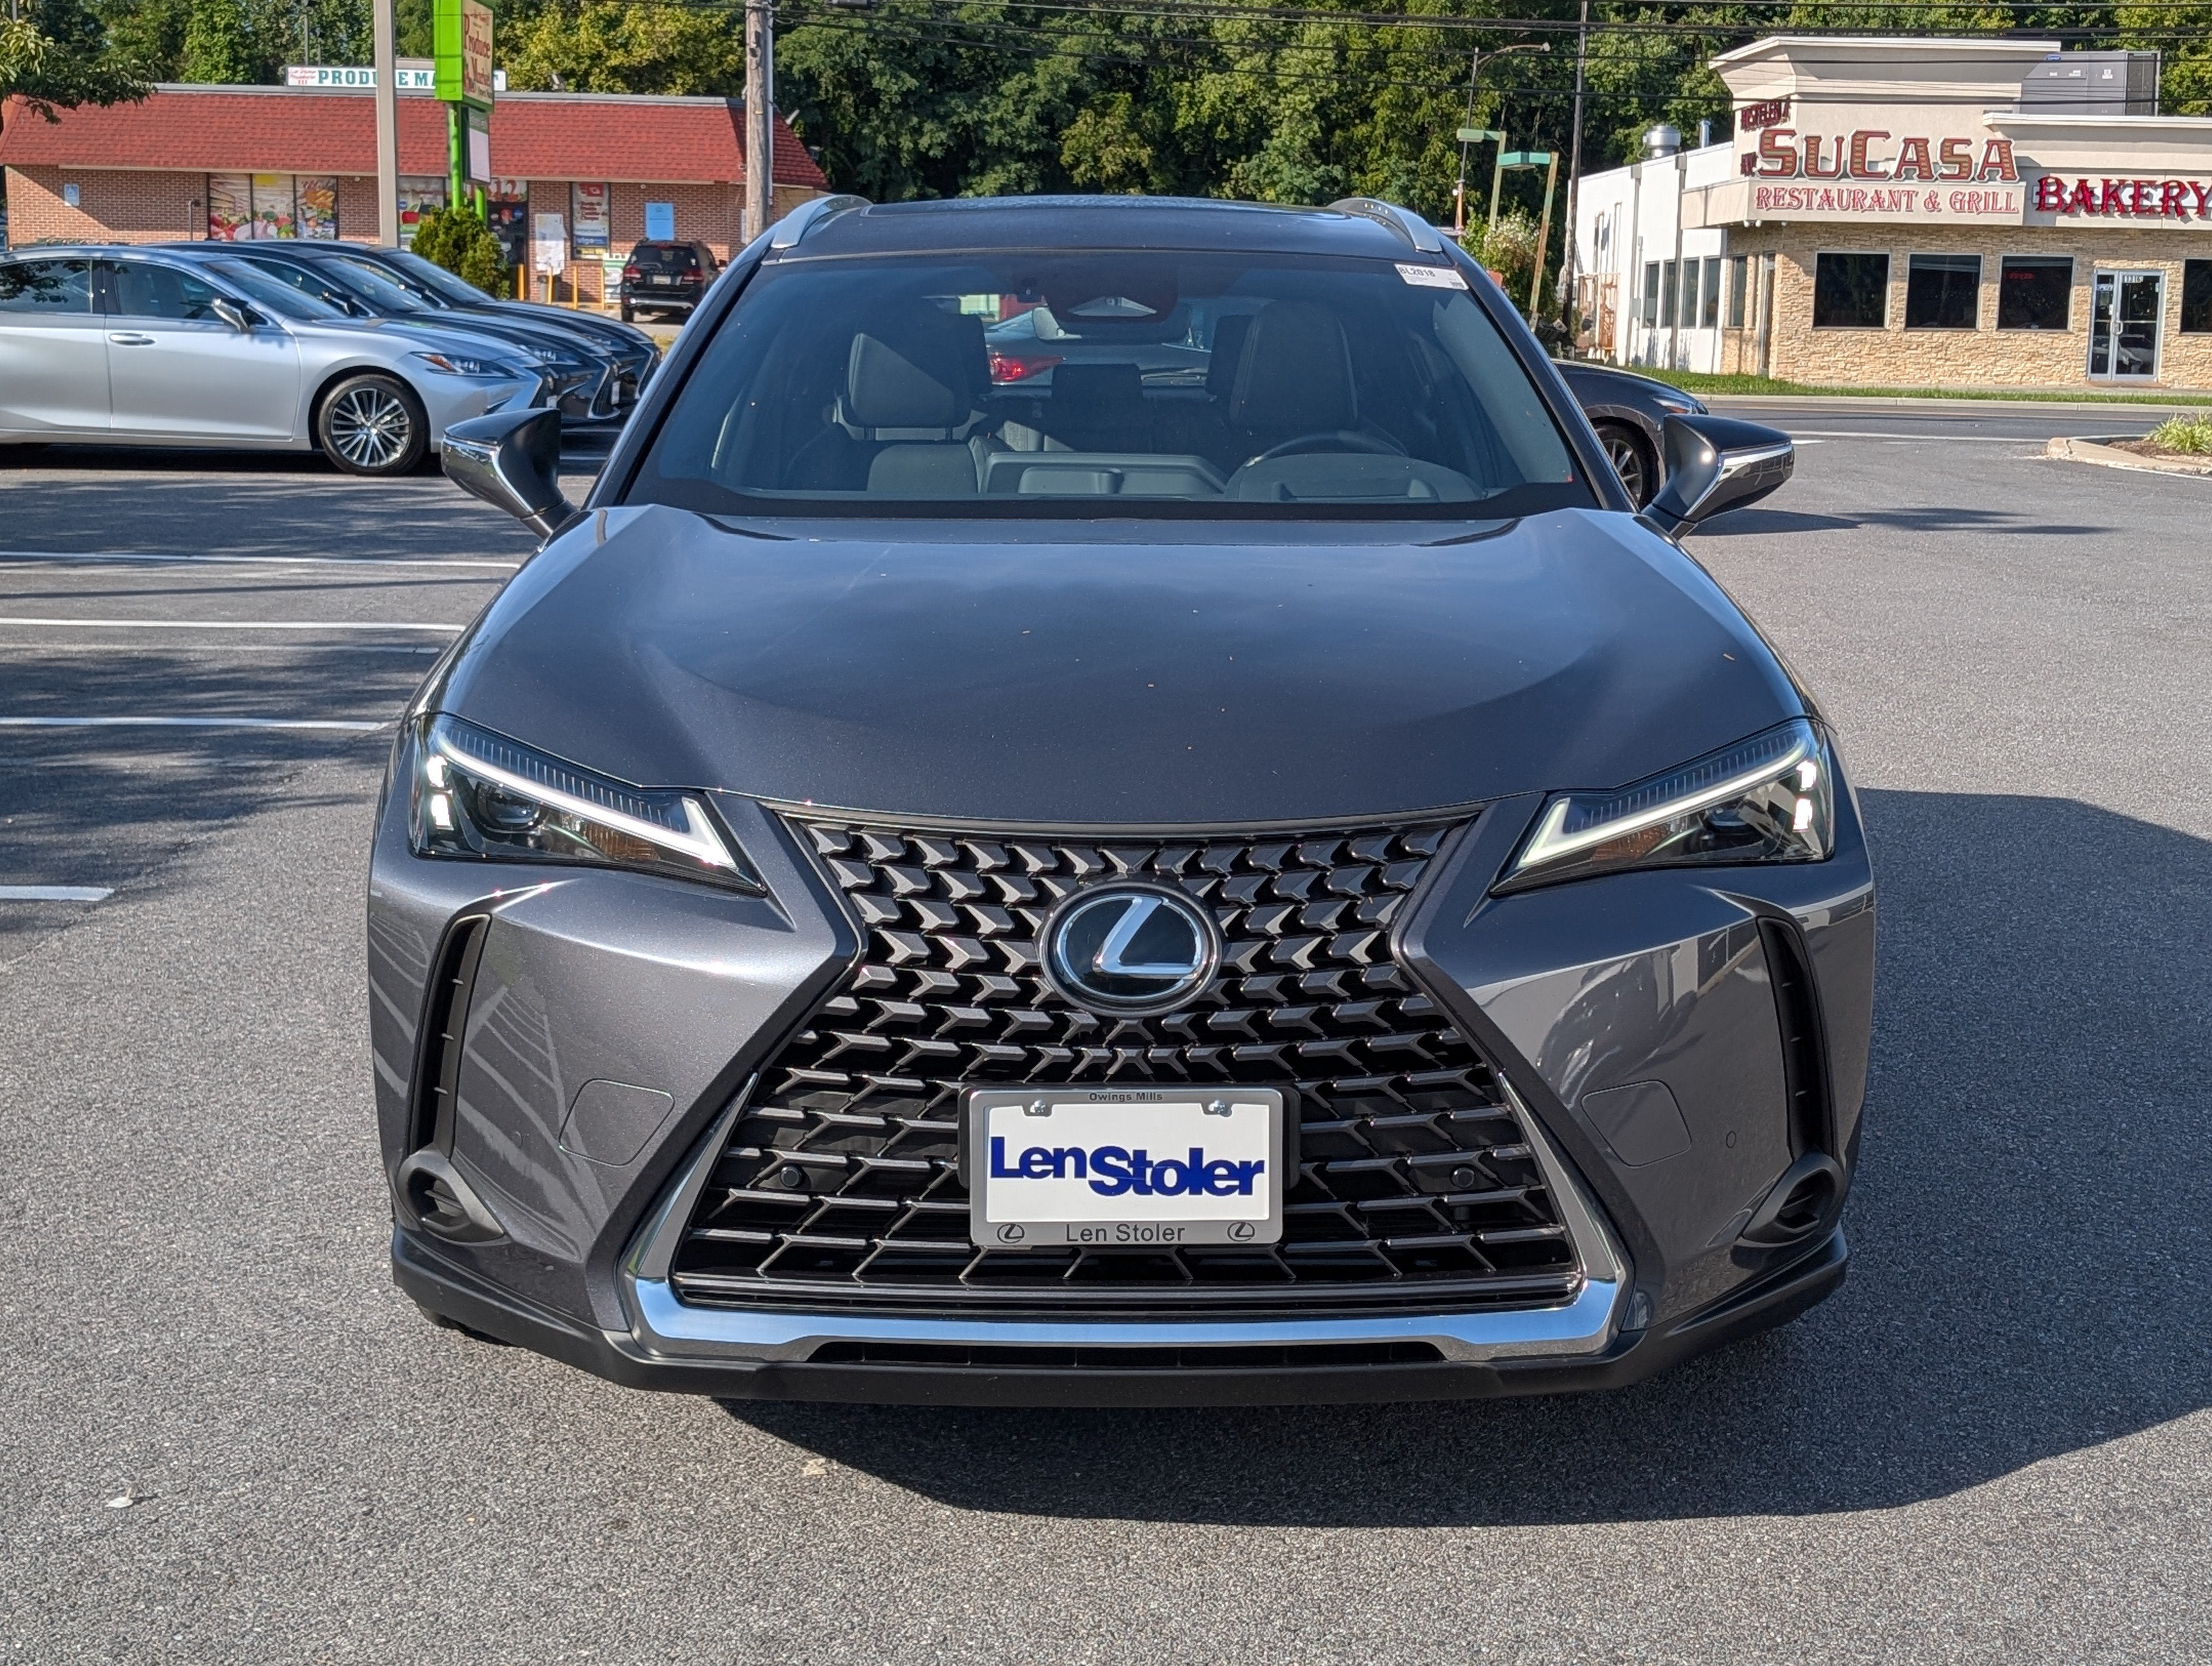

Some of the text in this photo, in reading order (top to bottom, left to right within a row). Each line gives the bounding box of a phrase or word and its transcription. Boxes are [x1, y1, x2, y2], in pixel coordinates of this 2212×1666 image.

[1756, 187, 2020, 214] RESTAURANT & GRILL
[2035, 175, 2212, 217] BAKERY
[1089, 1092, 1163, 1102] Owings Mills
[1066, 1223, 1185, 1241] Len Stoler
